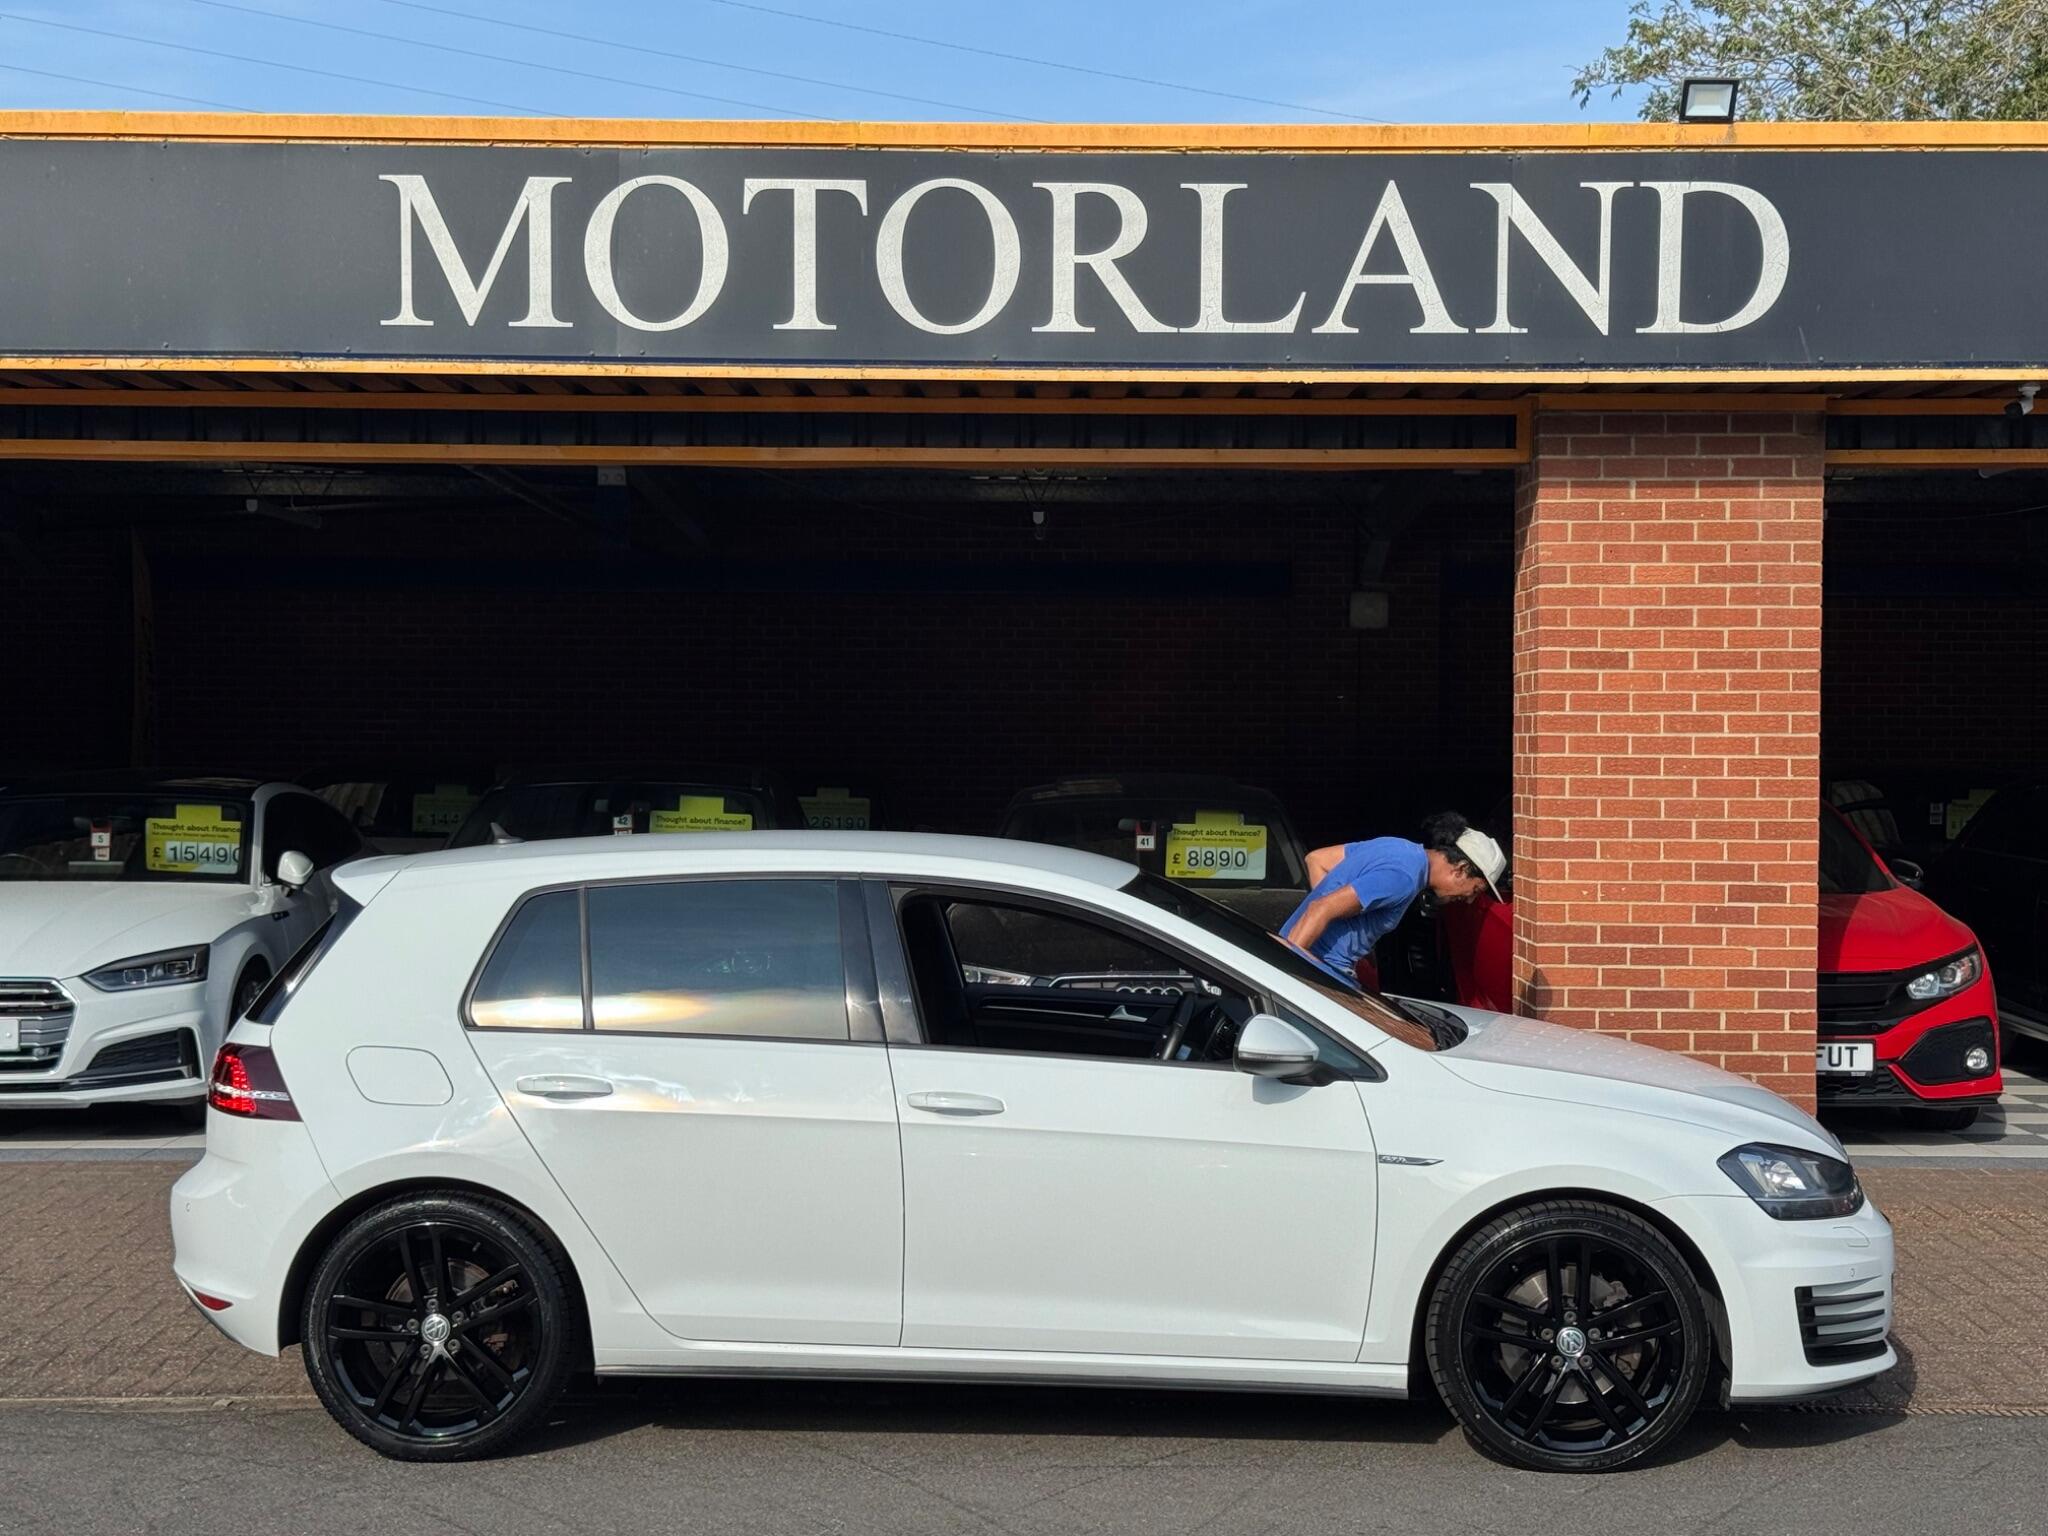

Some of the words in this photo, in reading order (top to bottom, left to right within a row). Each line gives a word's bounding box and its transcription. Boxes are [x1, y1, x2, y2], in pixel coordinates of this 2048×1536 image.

[379, 174, 1790, 336] MOTORLAND
[656, 815, 687, 825] Thought
[690, 816, 713, 825] about
[714, 817, 747, 825] finance?
[152, 822, 184, 832] Thought
[186, 823, 209, 832] about
[1173, 828, 1204, 837] Thought
[1206, 829, 1227, 837] about
[1230, 829, 1262, 837] finance?
[1140, 837, 1149, 846] 41
[1172, 852, 1181, 865] £
[1187, 850, 1247, 867] 8890
